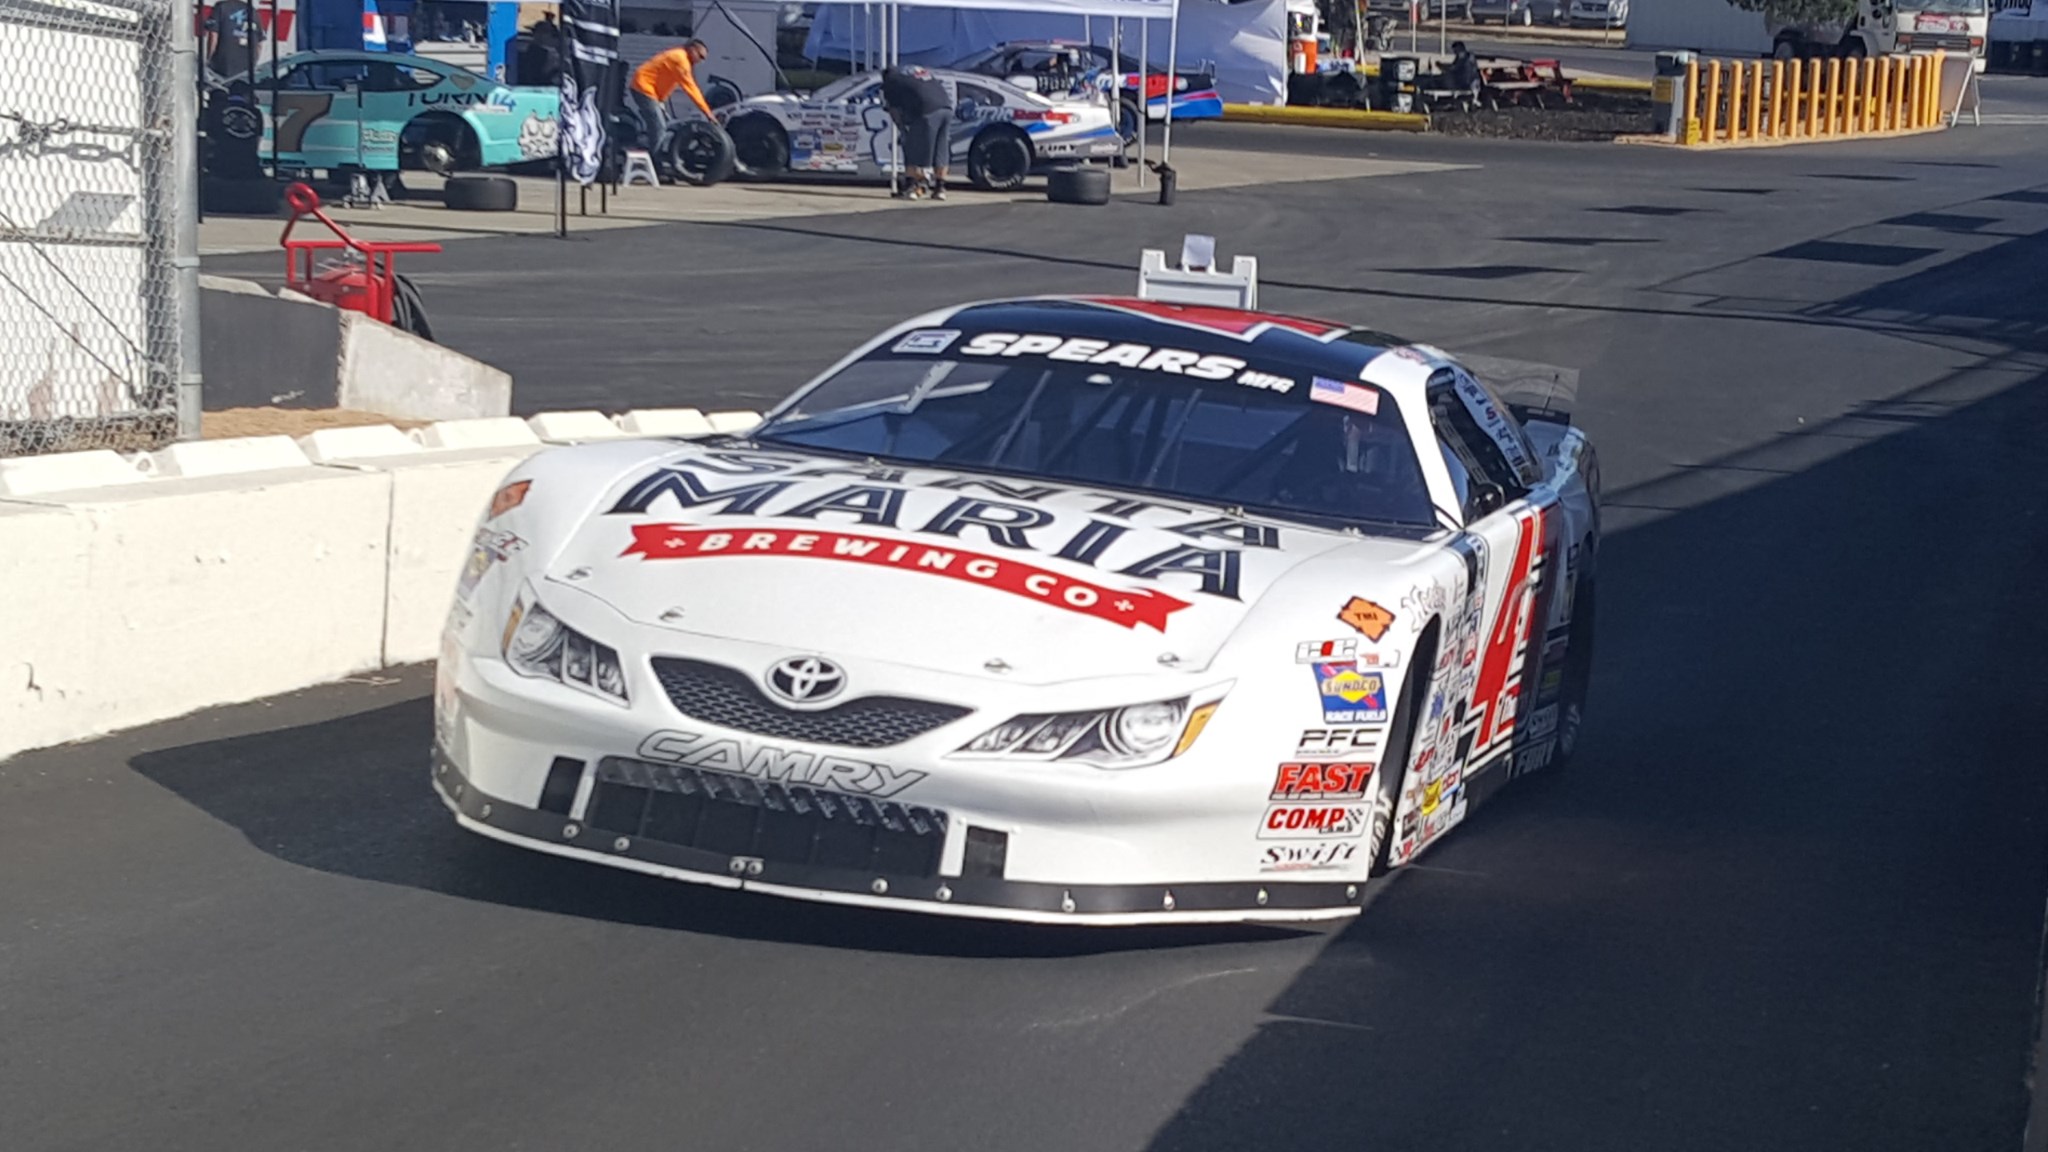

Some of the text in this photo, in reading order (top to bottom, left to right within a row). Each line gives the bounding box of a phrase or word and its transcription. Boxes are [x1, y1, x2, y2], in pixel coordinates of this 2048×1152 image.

[960, 333, 1247, 380] SPEARS
[1236, 369, 1295, 393] MFG
[601, 467, 1246, 604] MARIA
[697, 532, 1099, 607] BREWING CO
[1324, 679, 1379, 693] SUNOCO
[1299, 728, 1382, 747] PFC
[636, 728, 931, 799] CAMRY
[1275, 763, 1373, 793] FAST
[1267, 807, 1346, 829] COMP
[1260, 842, 1358, 866] Swift
